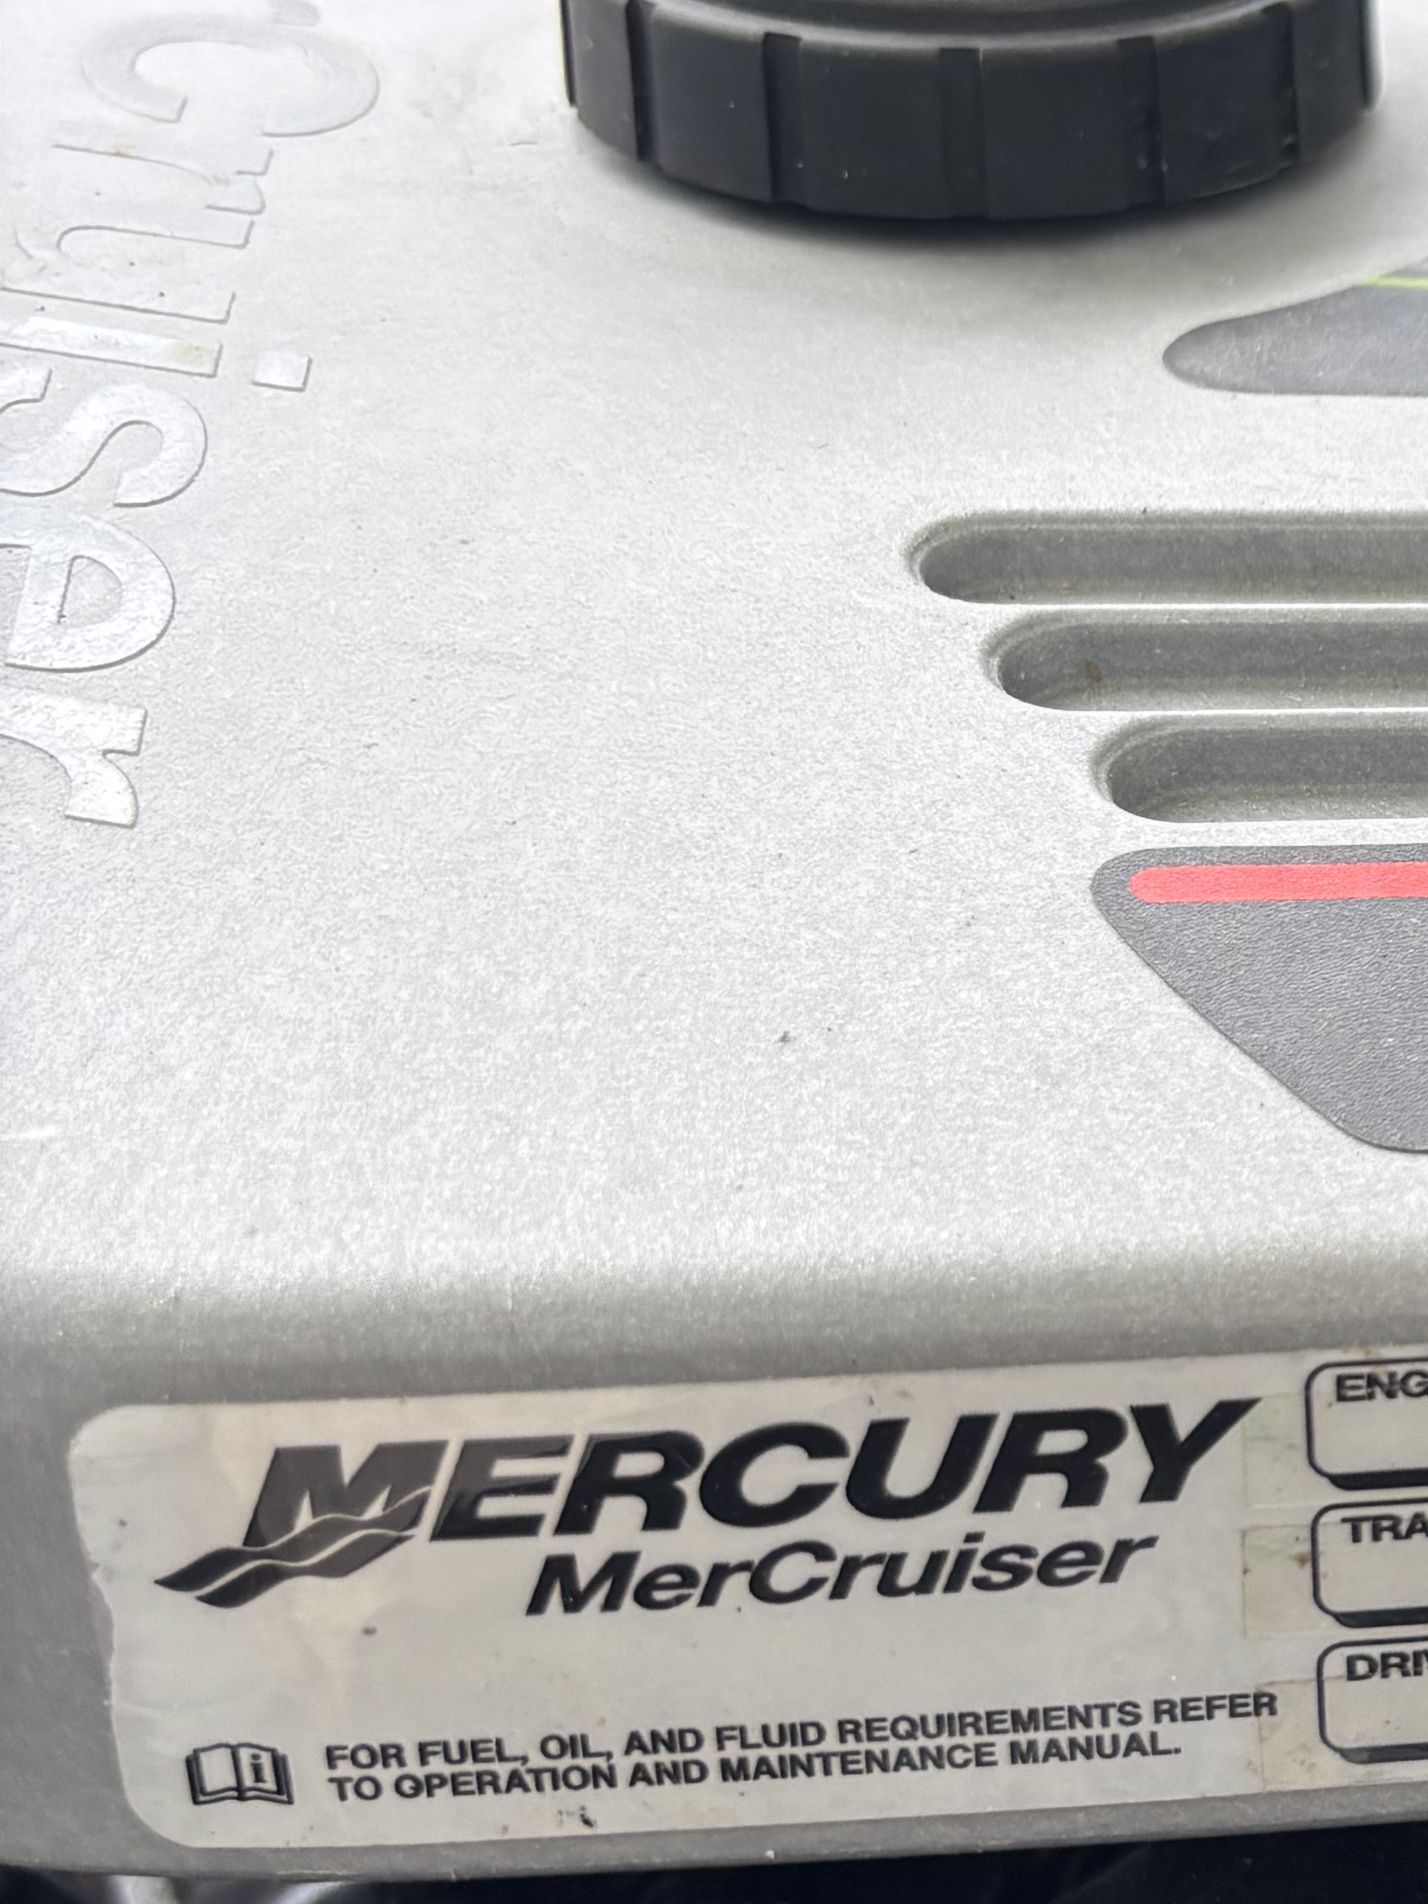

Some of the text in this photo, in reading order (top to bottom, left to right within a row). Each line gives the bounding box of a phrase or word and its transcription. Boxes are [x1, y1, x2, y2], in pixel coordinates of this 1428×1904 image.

[243, 1397, 1264, 1546] MERCURY
[524, 1530, 1160, 1616] MerCruiser
[325, 1691, 1279, 1770] FOR FUEL, OIL, AND FLUID REQUIREMENTS REFER
[328, 1729, 1183, 1803] TO OPERATION AND MAINTENANCE MANUAL.
